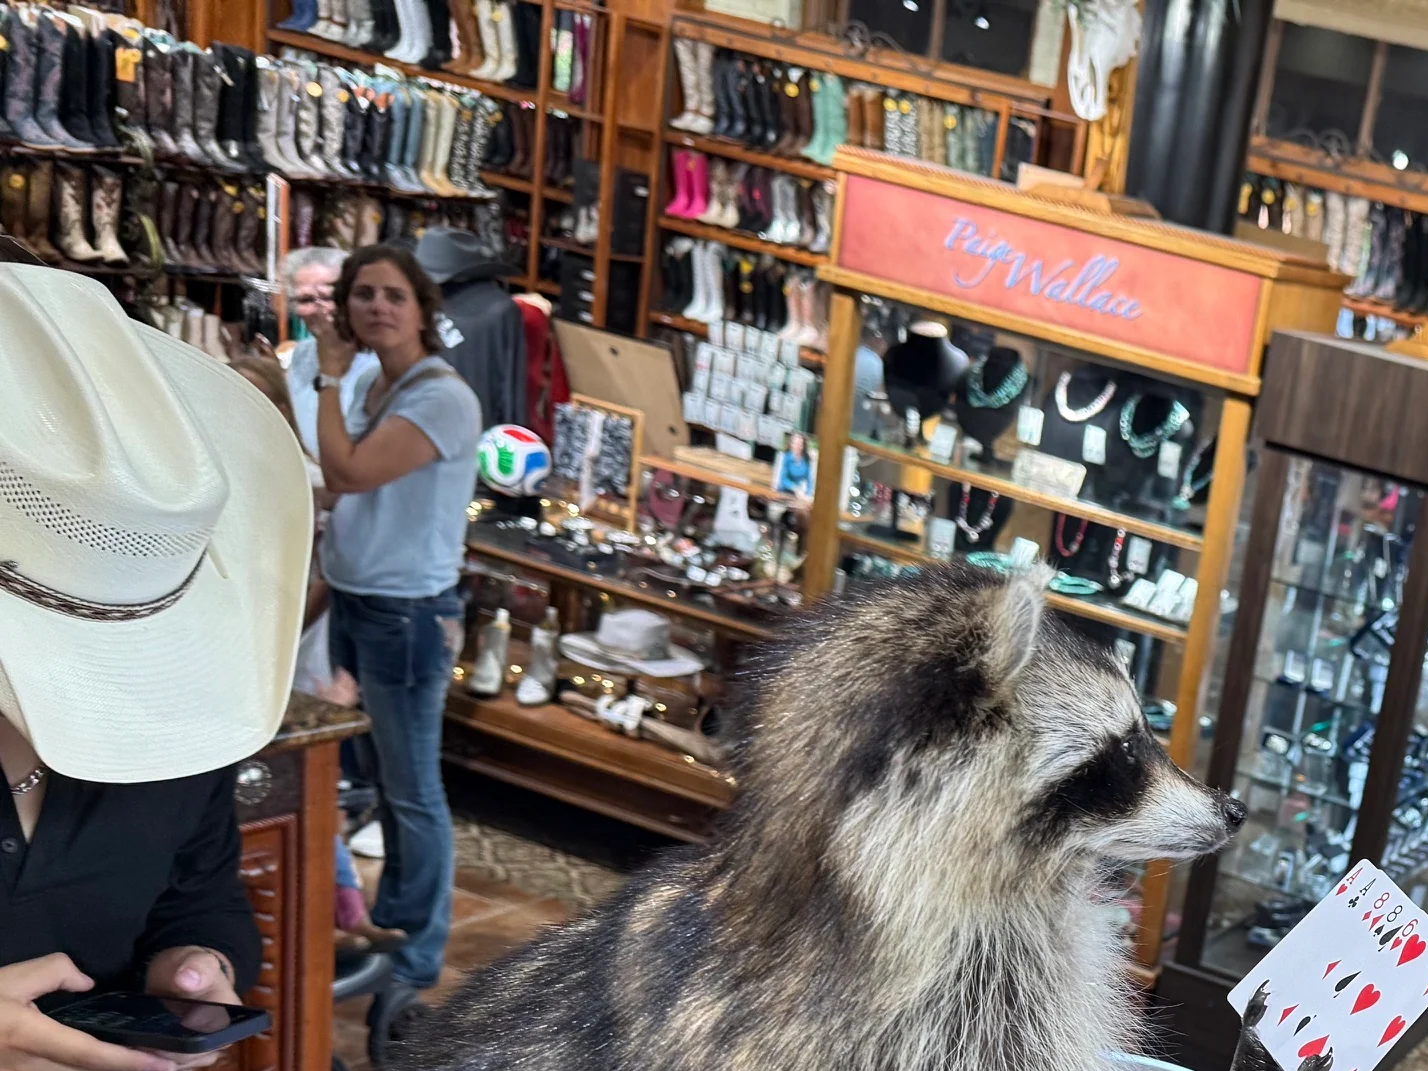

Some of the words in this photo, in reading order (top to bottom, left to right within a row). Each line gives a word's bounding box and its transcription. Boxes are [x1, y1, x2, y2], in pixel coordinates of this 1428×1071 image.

[1004, 252, 1143, 321] Wallace
[1346, 867, 1363, 884] A
[1360, 878, 1377, 896] A
[1373, 892, 1390, 909] 8
[1386, 905, 1403, 922] 8
[1402, 919, 1419, 937] 6
